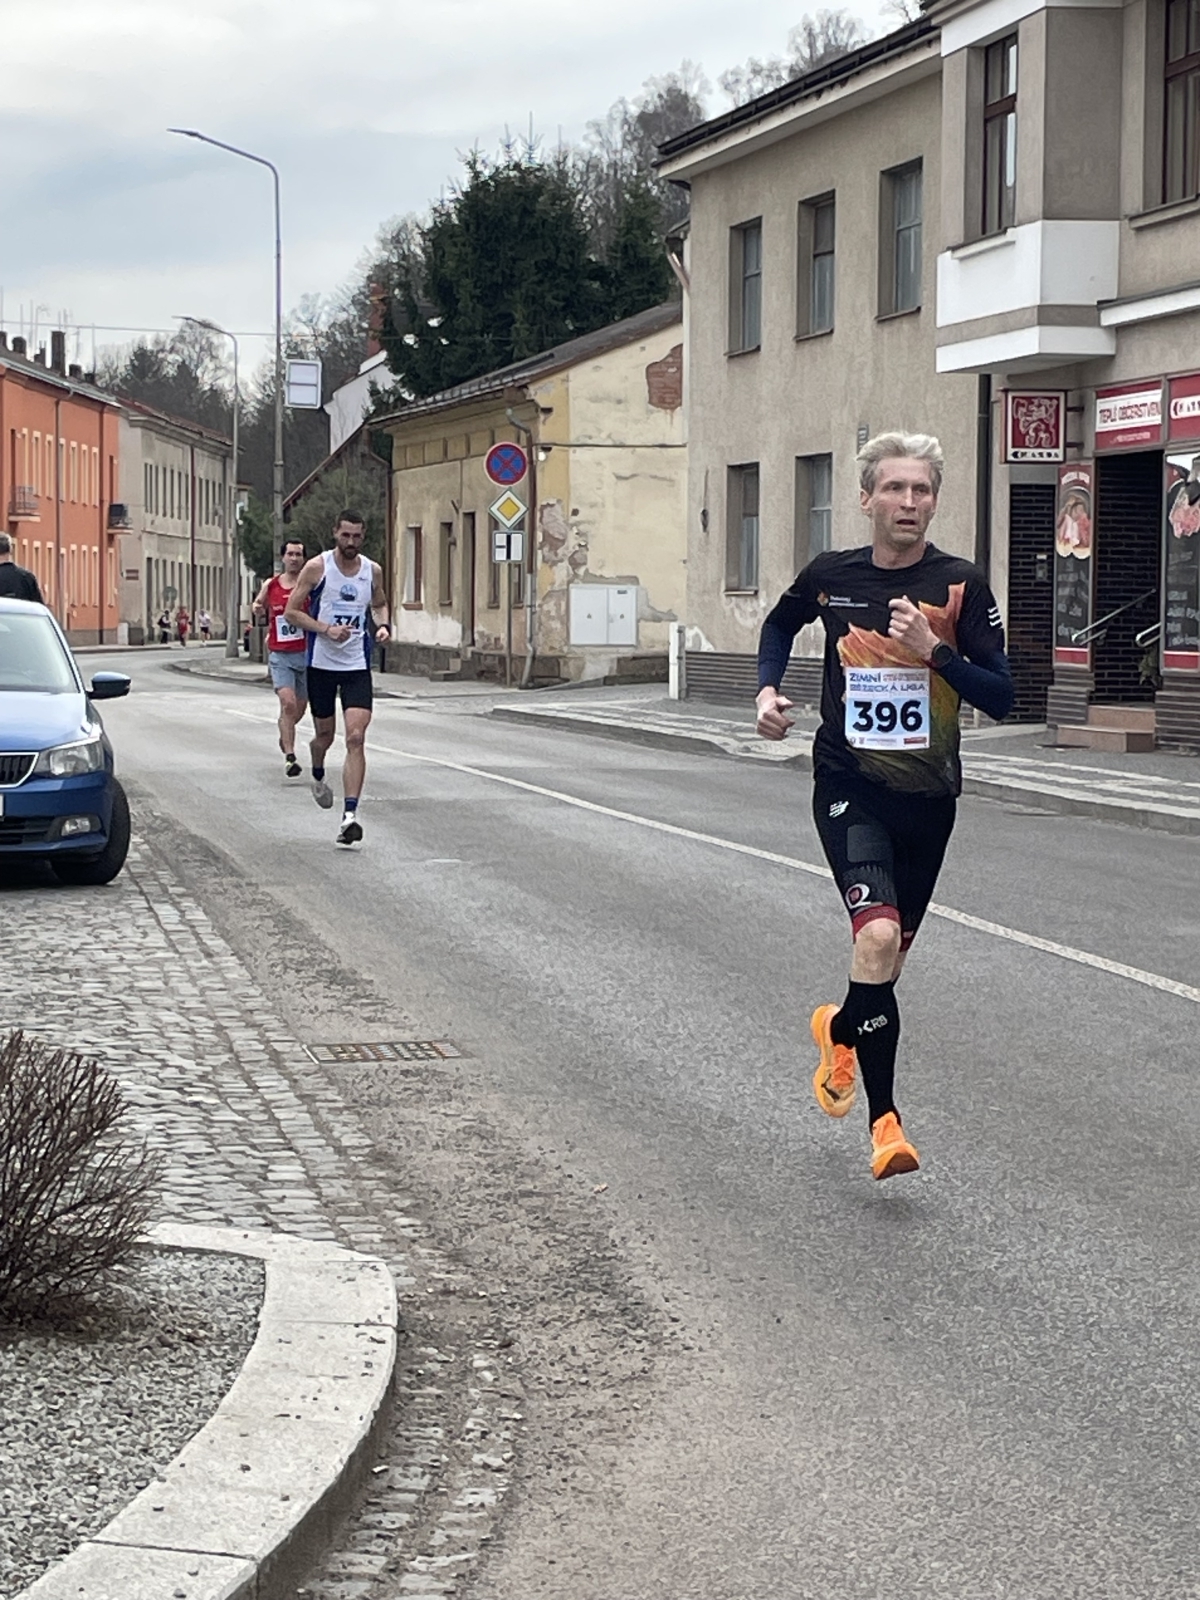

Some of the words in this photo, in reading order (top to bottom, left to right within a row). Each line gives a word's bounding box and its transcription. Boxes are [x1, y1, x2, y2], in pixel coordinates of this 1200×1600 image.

[333, 614, 361, 629] 374
[849, 671, 882, 683] ZIMNÍ
[900, 682, 926, 692] LIGA
[852, 699, 923, 733] 396
